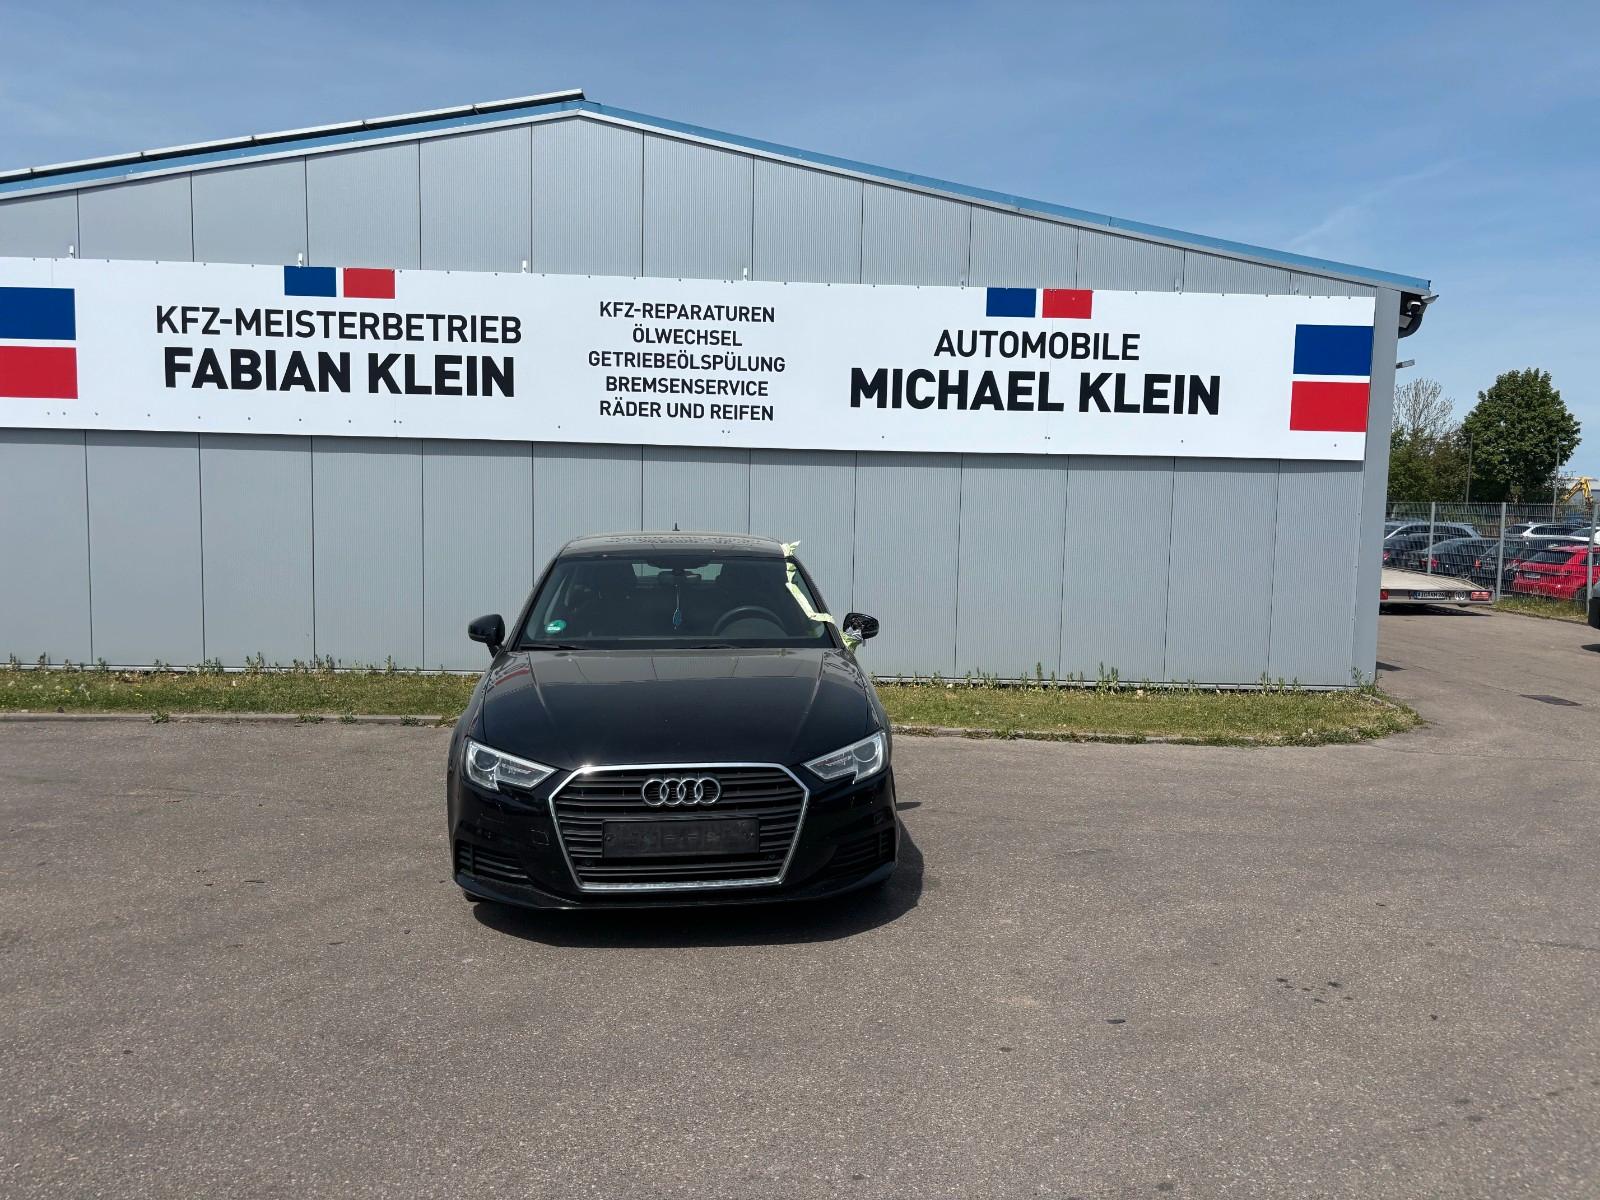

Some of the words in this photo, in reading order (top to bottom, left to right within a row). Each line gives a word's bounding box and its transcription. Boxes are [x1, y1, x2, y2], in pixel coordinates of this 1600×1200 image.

[600, 301, 775, 322] KFZ-REPARATUREN
[156, 305, 522, 344] KFZ-MEISTERBETRIEB
[632, 323, 743, 347] ÖLWECHSEL
[934, 329, 1141, 361] AUTOMOBILE
[164, 346, 351, 393] FABIAN
[368, 353, 515, 398] KLEIN
[588, 350, 786, 373] GETRIEBEÖLSPÜLUNG
[606, 375, 769, 397] BREMSENSERVICE
[850, 367, 1064, 412] MICHAEL
[1079, 372, 1221, 416] KLEIN
[599, 396, 662, 418] RÄDER
[666, 402, 705, 419] UND
[710, 403, 774, 421] REIFEN
